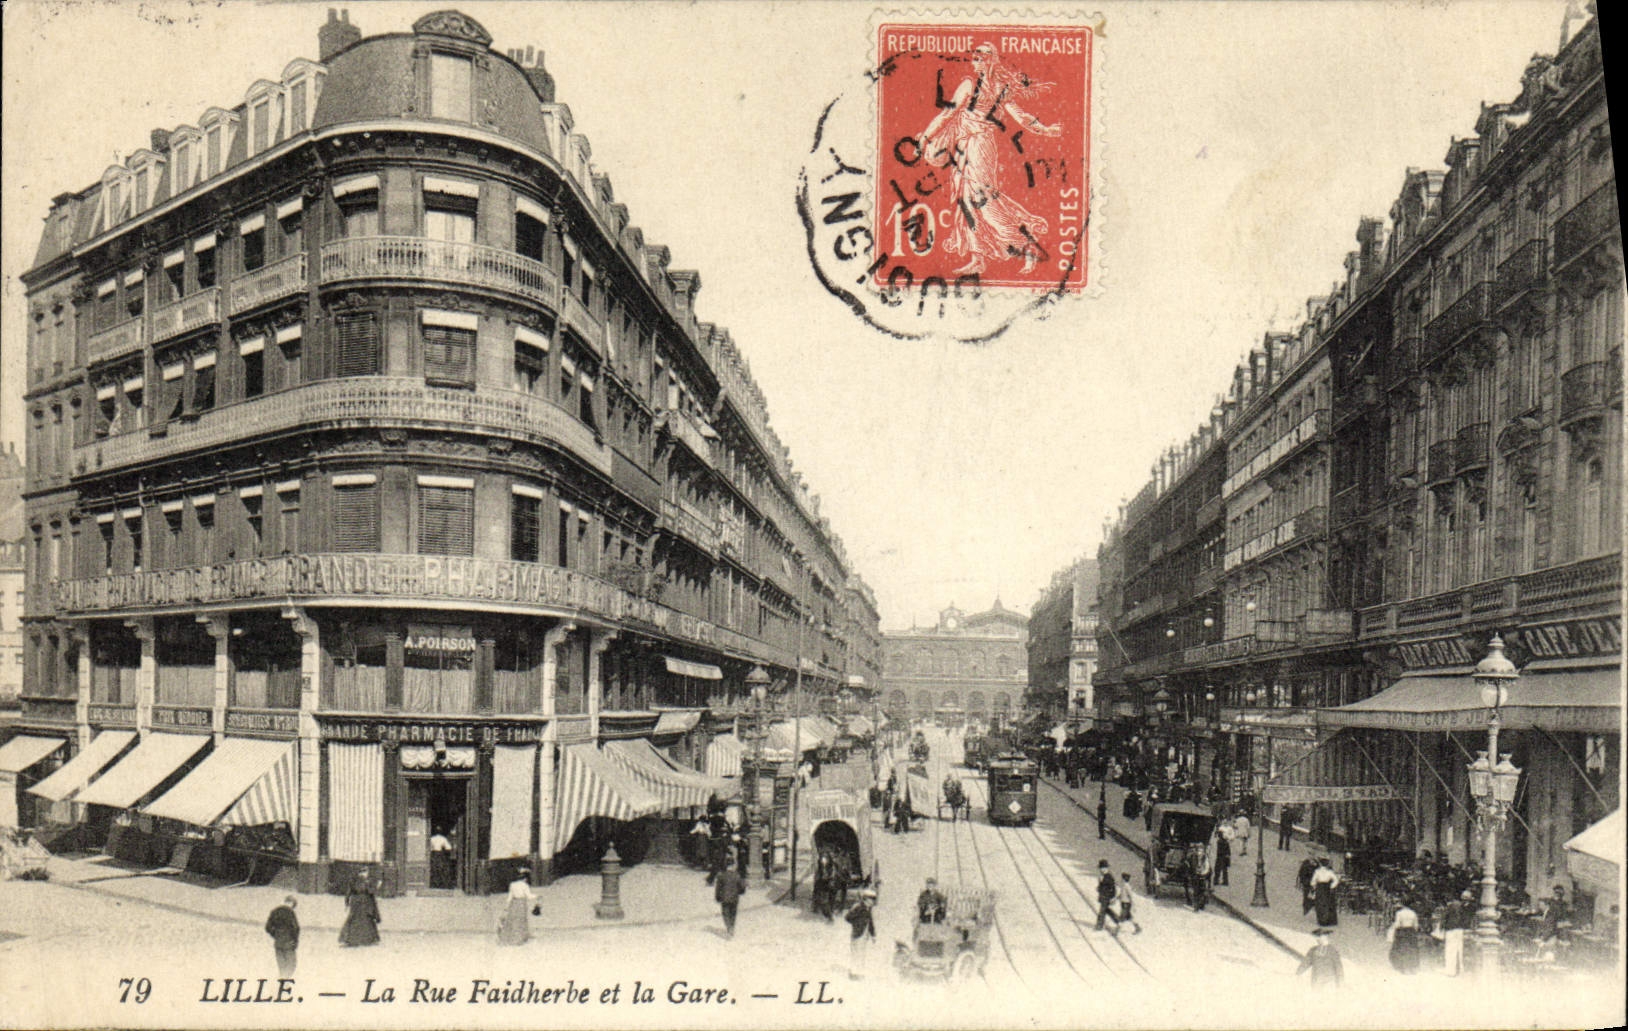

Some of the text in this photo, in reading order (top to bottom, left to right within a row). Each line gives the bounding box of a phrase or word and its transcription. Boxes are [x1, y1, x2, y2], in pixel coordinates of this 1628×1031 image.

[887, 36, 1084, 56] REPUBLIQUE FRANÇAISE
[1057, 186, 1080, 272] POSTES
[1577, 618, 1621, 653] JEA
[319, 723, 370, 740] GRANDE
[377, 724, 475, 743] PHARMACIE
[482, 726, 501, 743] DE
